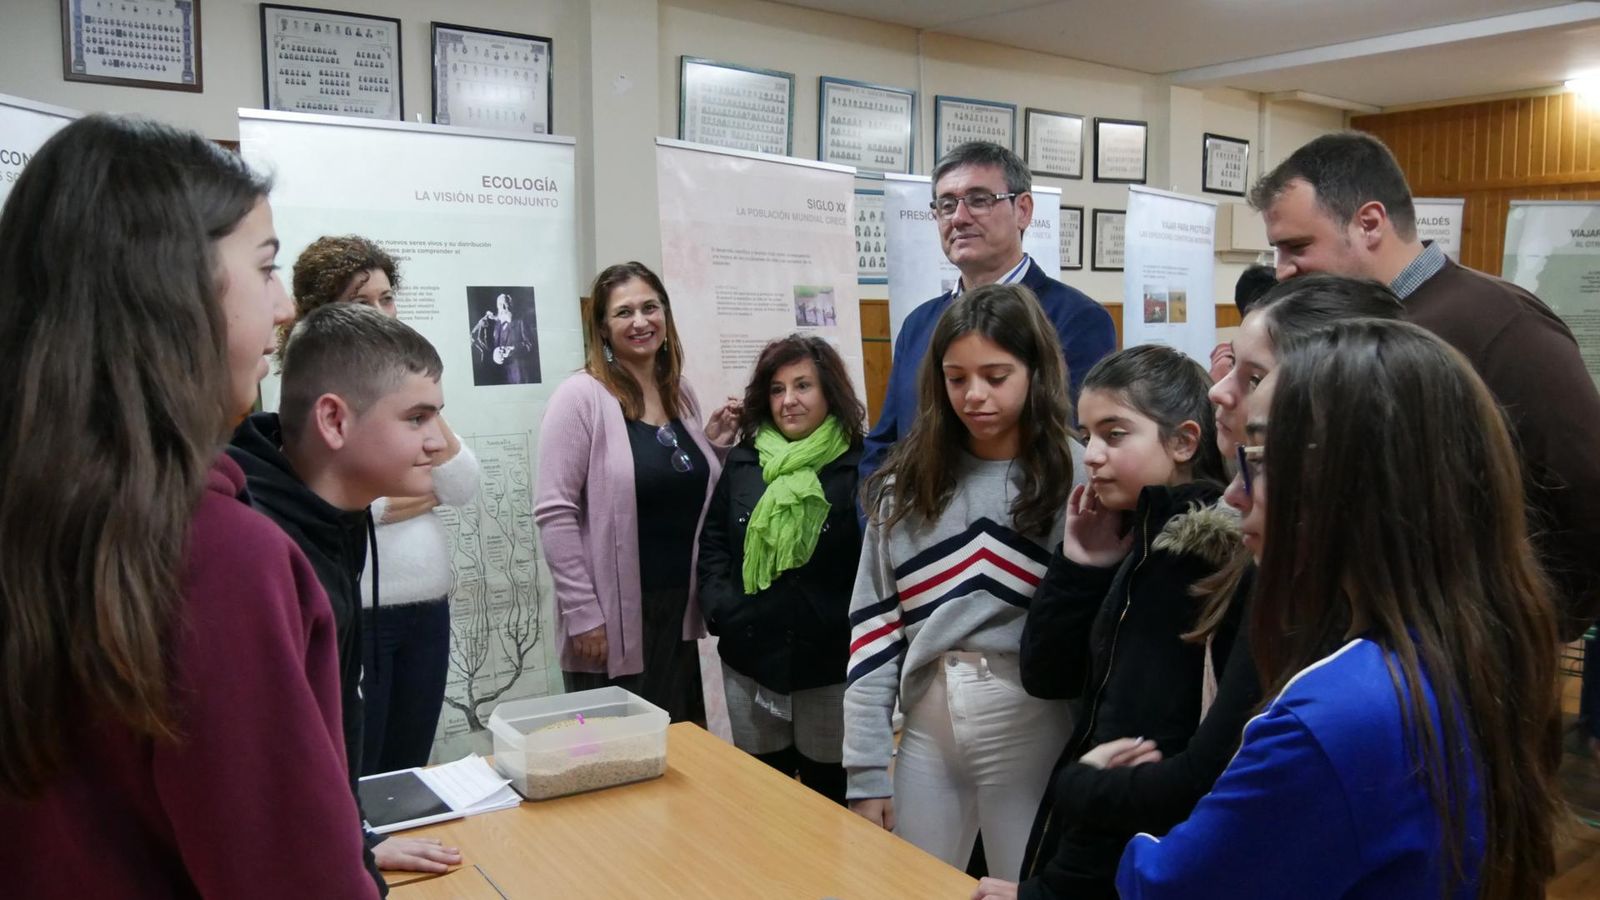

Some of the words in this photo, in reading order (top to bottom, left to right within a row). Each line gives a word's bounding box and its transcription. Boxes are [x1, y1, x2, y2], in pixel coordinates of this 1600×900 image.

[0, 149, 33, 169] CON
[482, 175, 558, 192] ECOLOGÍA
[415, 190, 430, 201] LA
[433, 191, 474, 203] VISIÓN
[478, 194, 493, 204] DE
[497, 194, 559, 208] CONJUNTO
[807, 198, 834, 212] SIGLO
[736, 207, 746, 216] LA
[748, 207, 790, 221] POBLACIÓN
[792, 212, 824, 223] MUNDIAL
[900, 210, 936, 221] PRESIO
[1416, 216, 1450, 226] VALDÉS
[1030, 219, 1051, 229] EMAS
